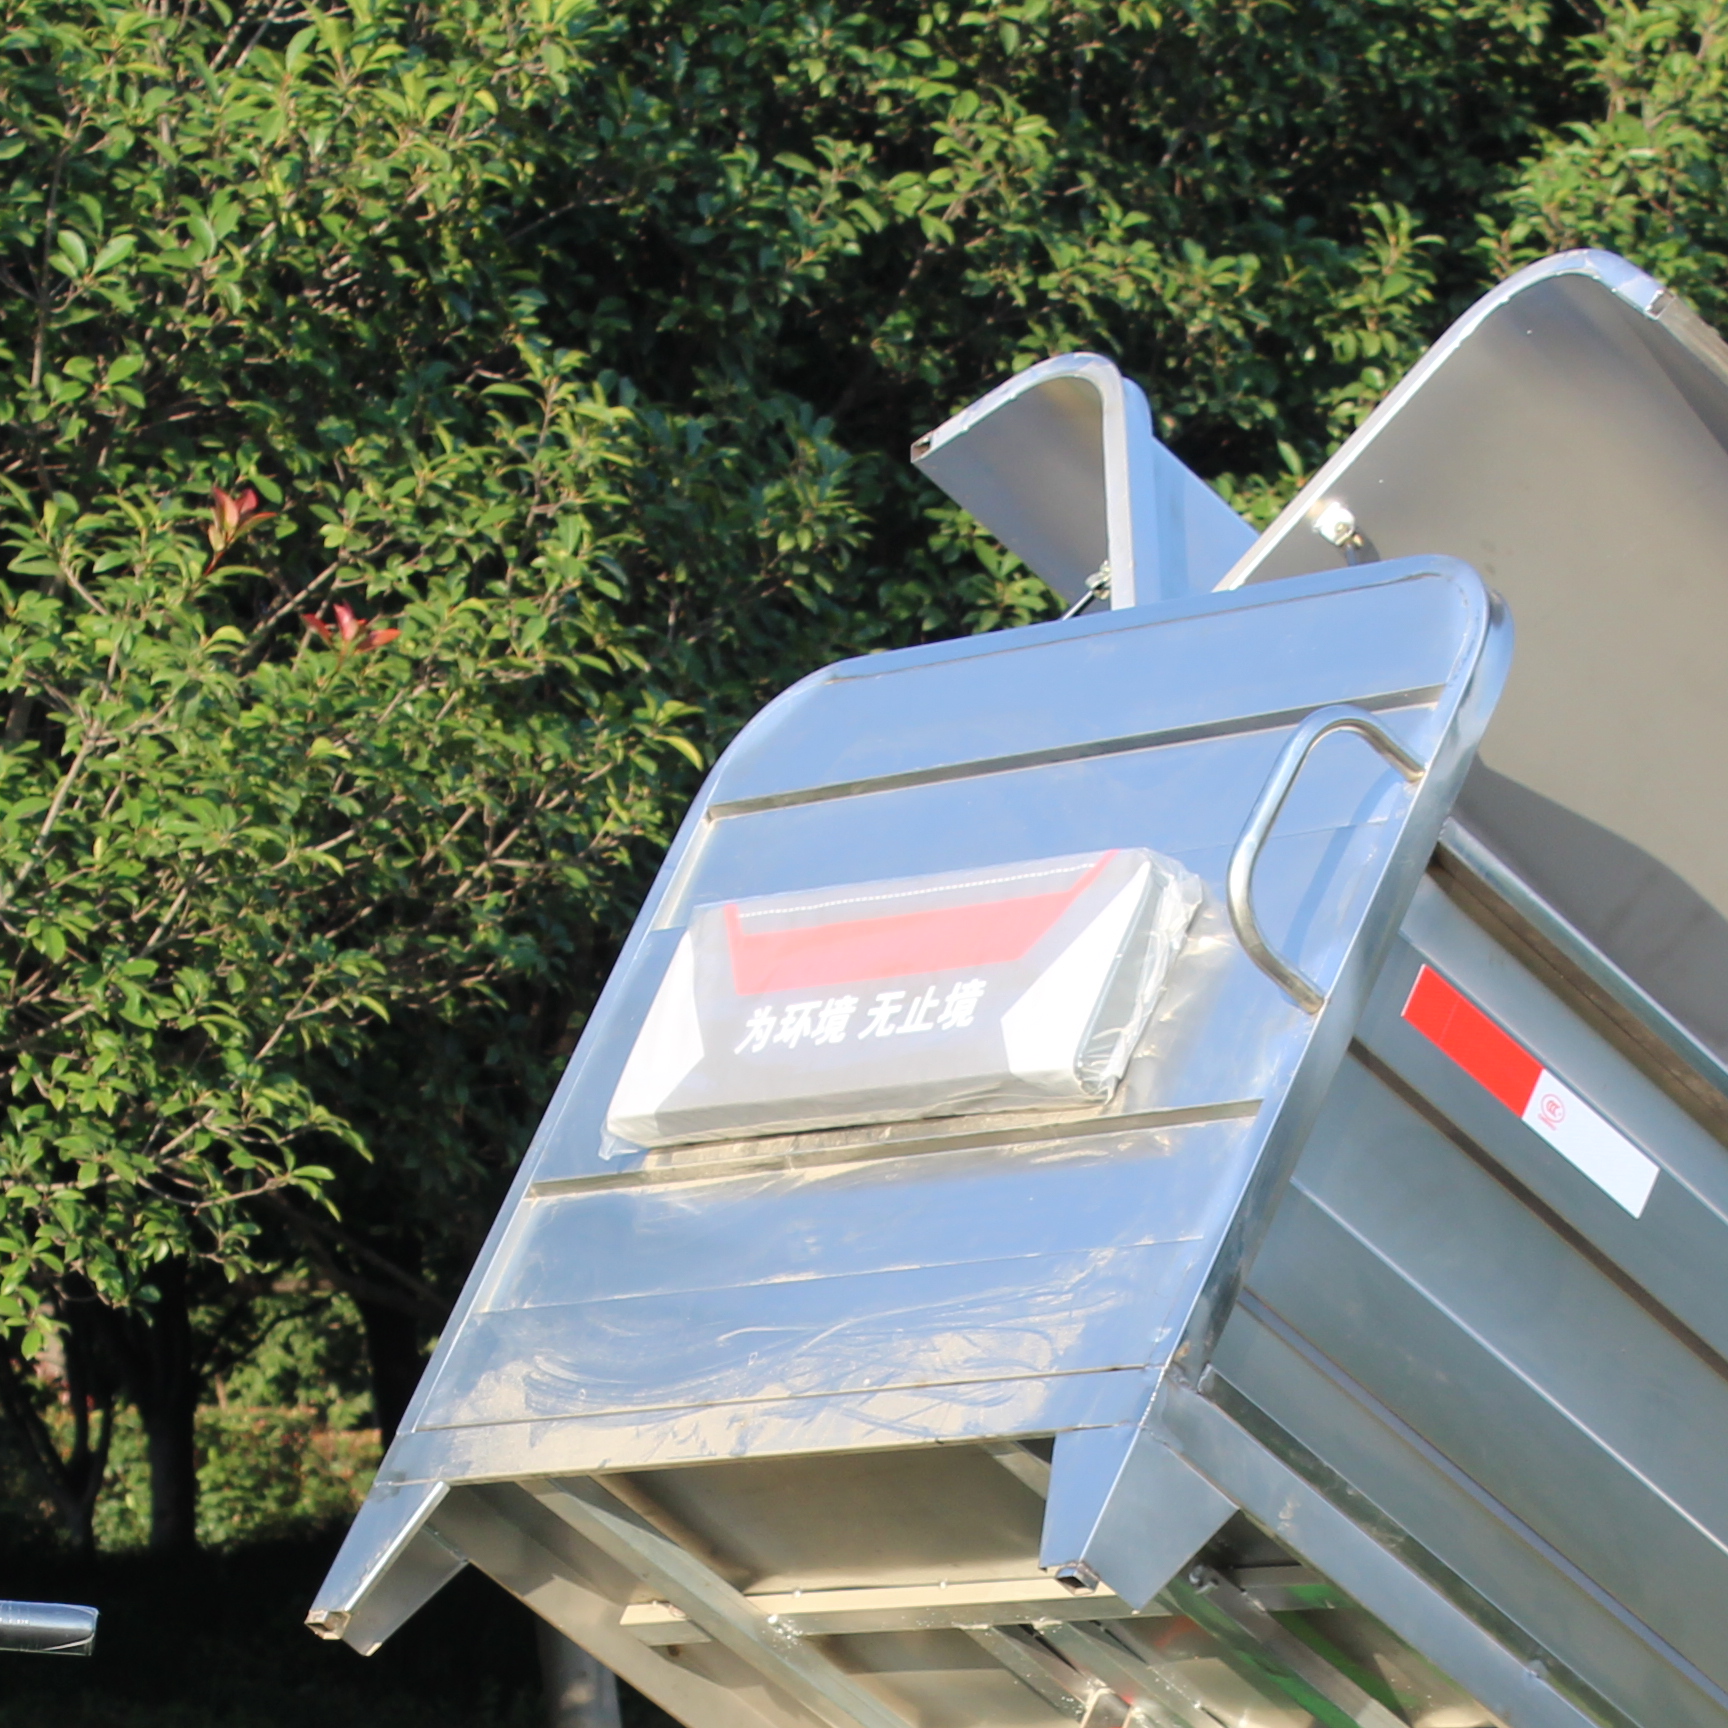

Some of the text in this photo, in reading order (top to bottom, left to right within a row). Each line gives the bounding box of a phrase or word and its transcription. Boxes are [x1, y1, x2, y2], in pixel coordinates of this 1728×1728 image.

[734, 978, 988, 1056] 为环境 无止境
